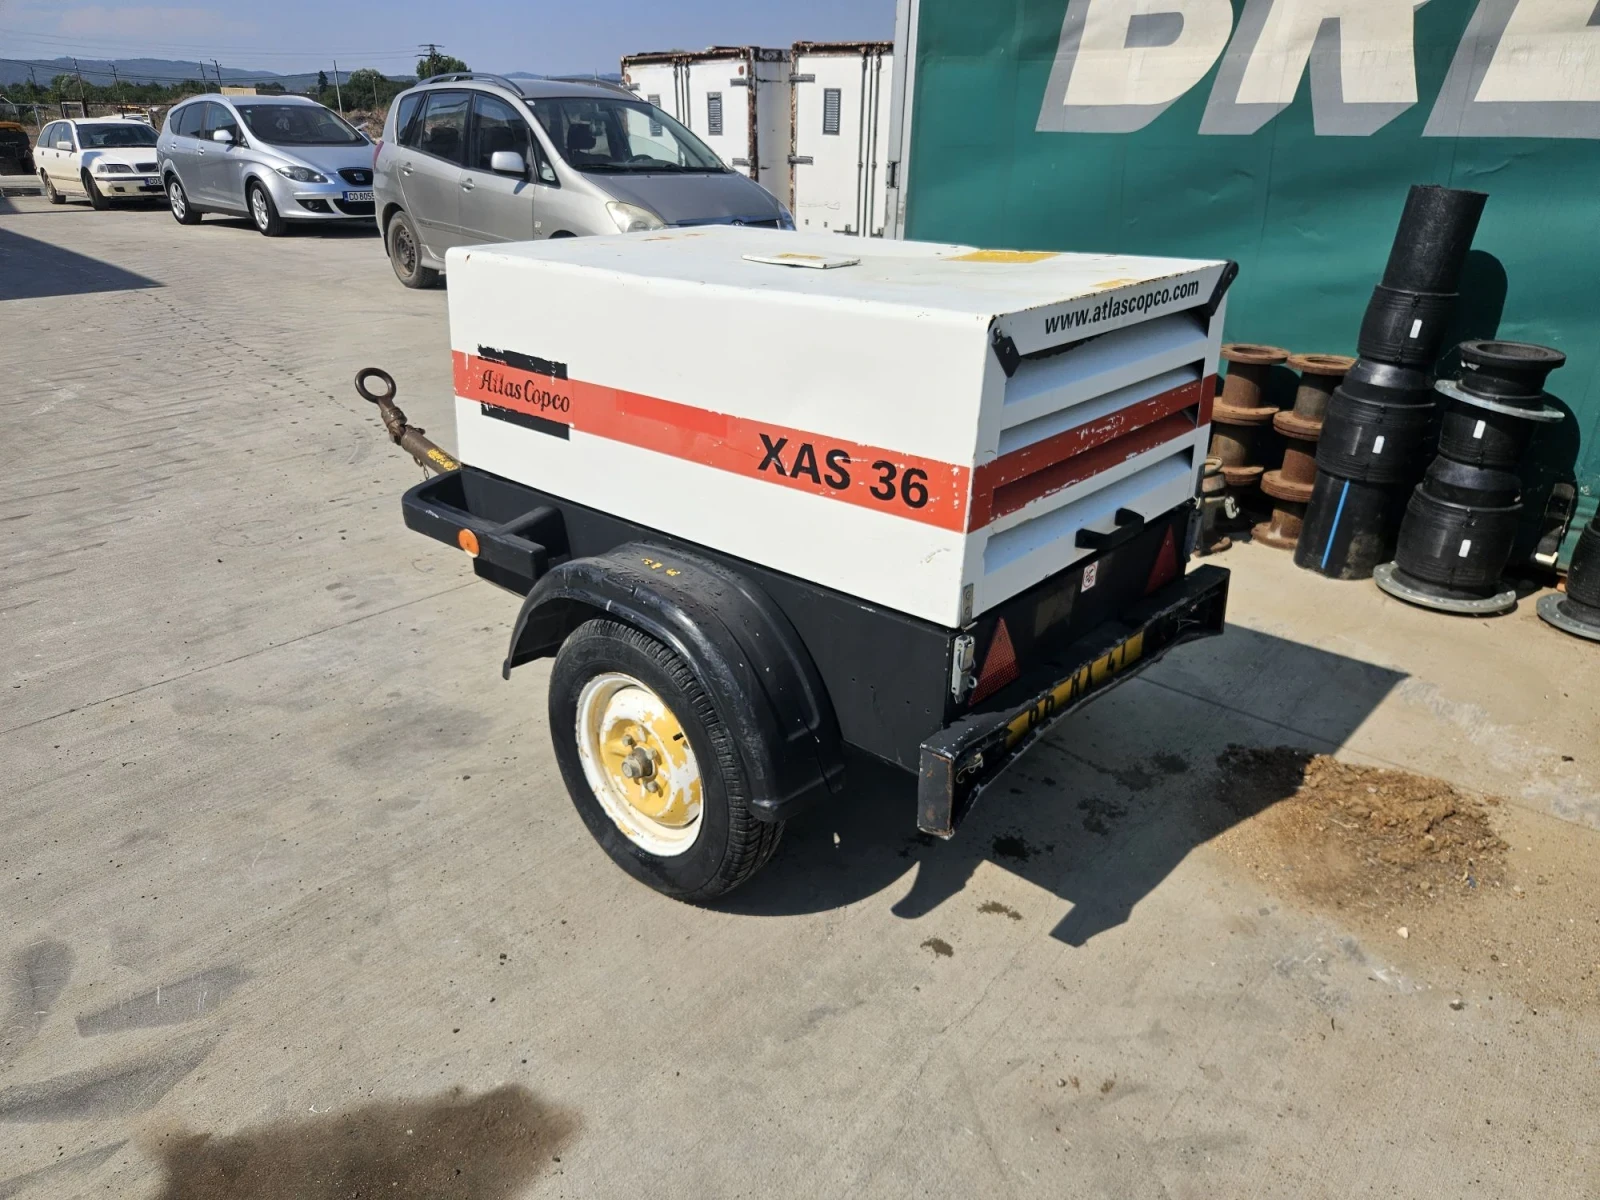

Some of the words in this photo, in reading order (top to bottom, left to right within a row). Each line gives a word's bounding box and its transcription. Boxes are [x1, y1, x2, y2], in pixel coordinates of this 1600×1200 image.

[1045, 280, 1199, 334] www.atlascopco.com
[523, 379, 570, 413] Copco
[757, 433, 852, 490] XAS
[869, 459, 929, 508] 36
